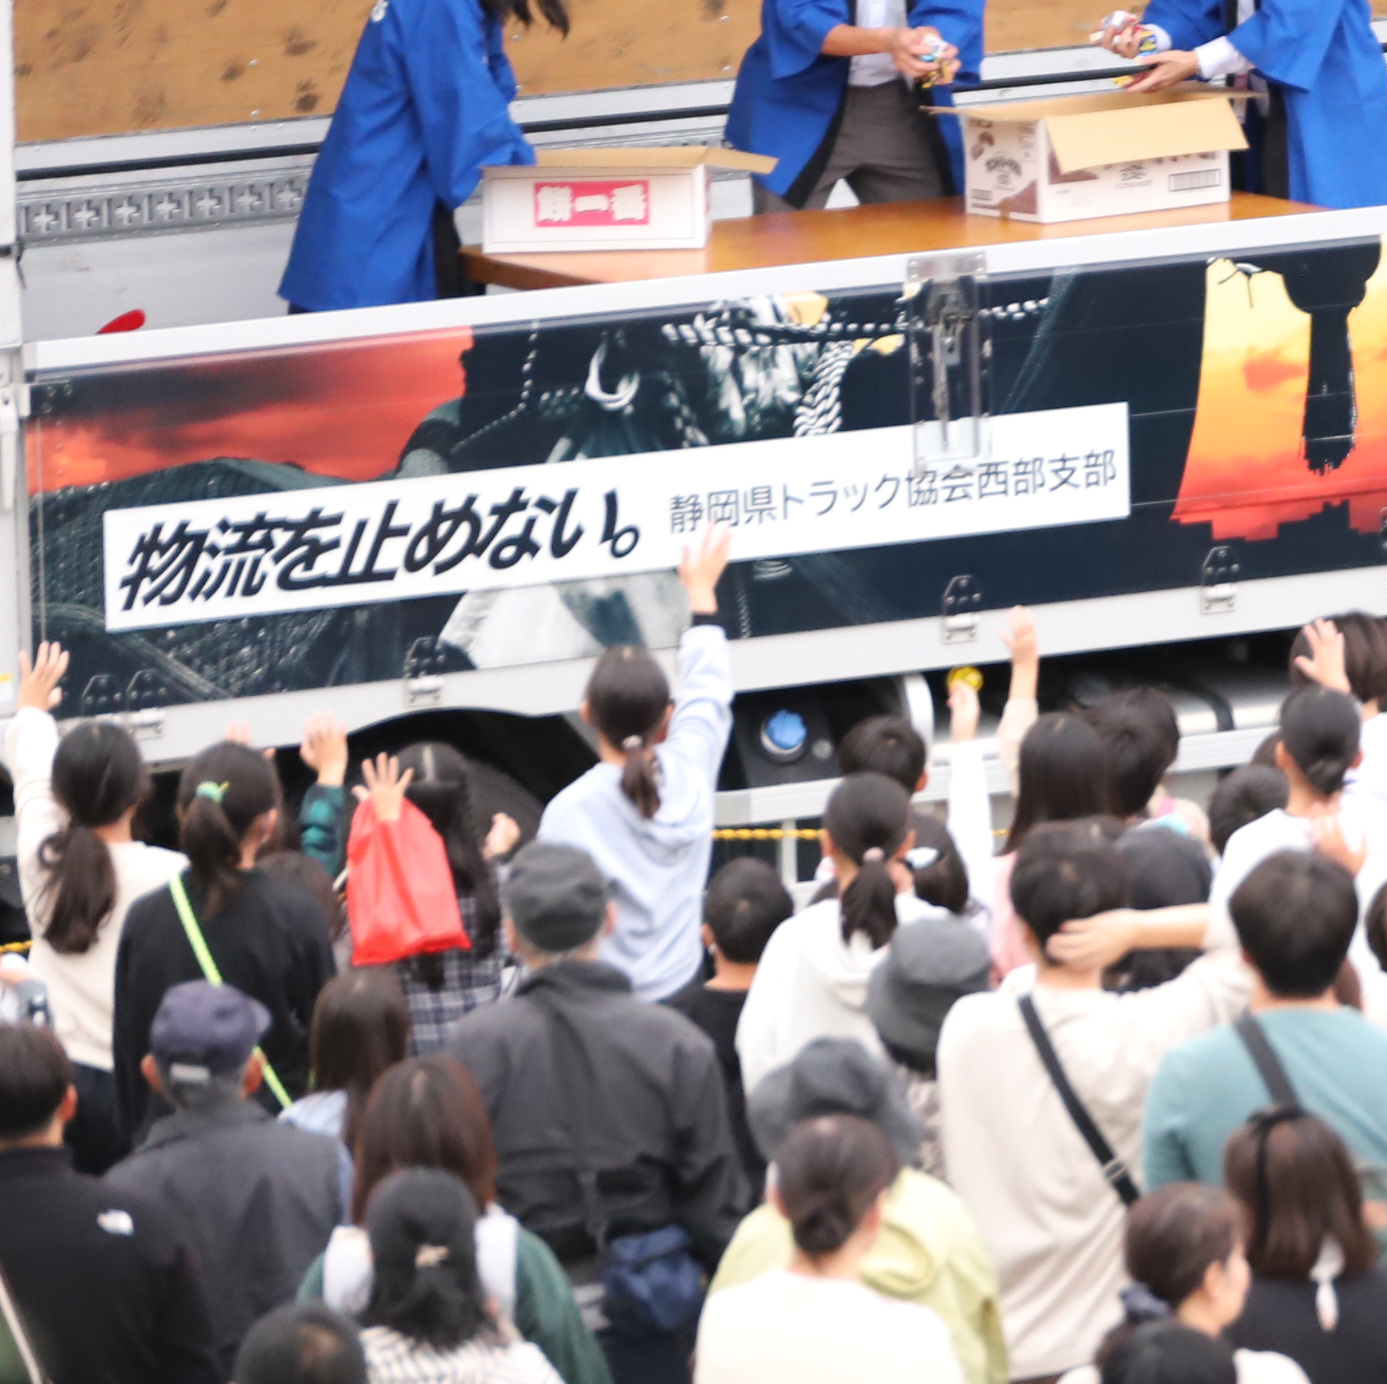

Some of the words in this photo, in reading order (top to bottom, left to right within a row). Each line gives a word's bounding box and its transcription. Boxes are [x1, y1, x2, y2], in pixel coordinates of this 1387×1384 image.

[121, 485, 641, 612] 物流を止めない。
[668, 448, 1118, 535] 静岡県トラック協会西部支部
